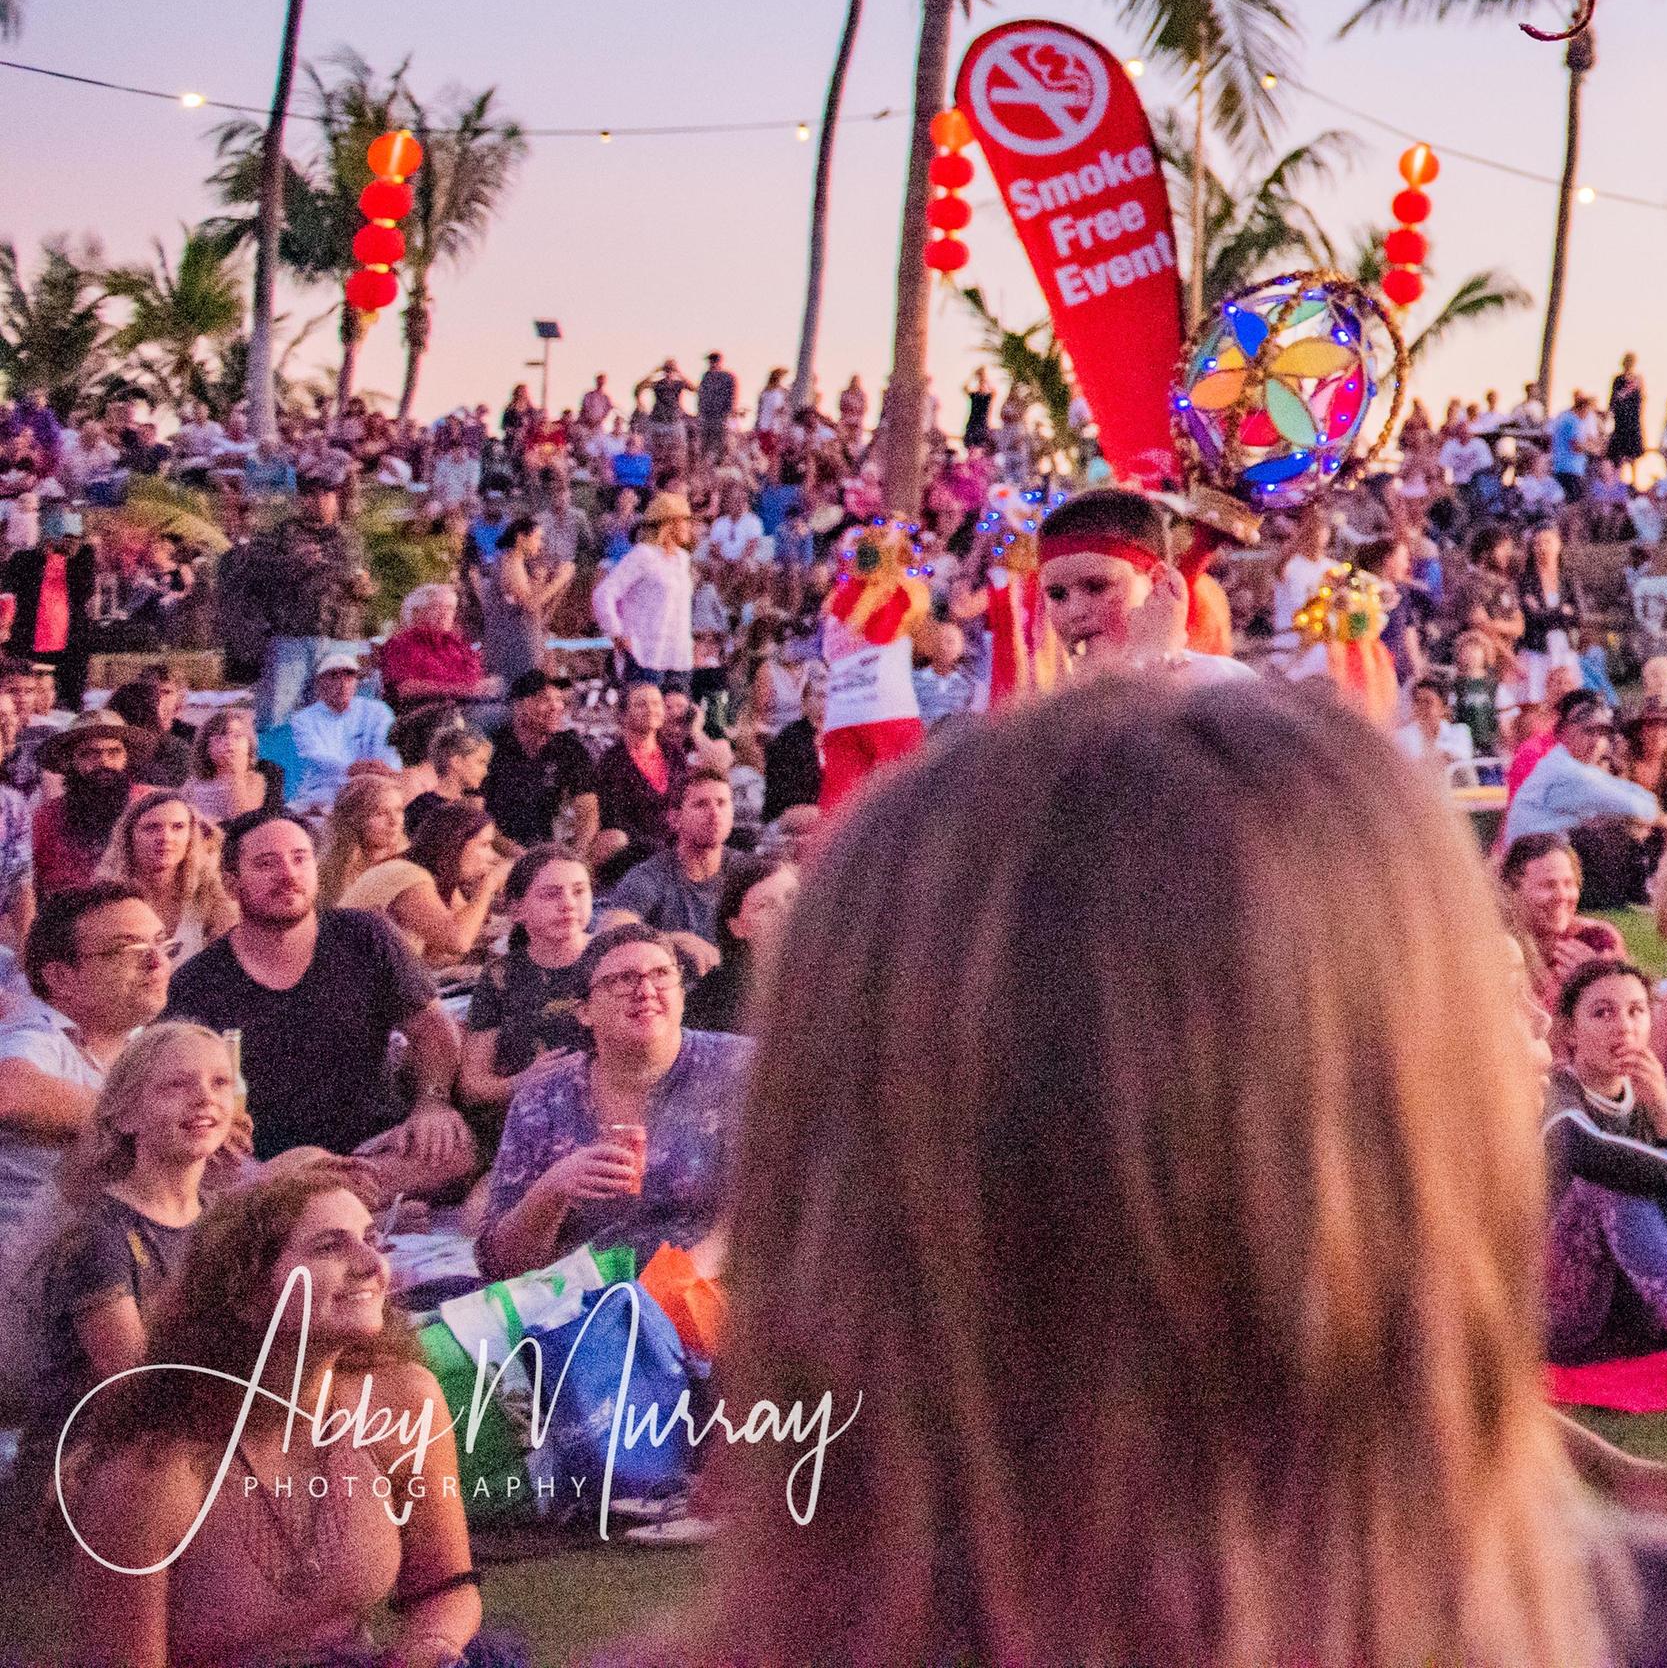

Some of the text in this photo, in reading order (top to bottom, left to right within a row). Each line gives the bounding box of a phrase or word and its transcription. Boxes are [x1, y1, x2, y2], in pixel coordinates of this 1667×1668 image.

[1010, 145, 1154, 219] Smoke
[1051, 200, 1145, 258] Free
[1056, 231, 1175, 306] Event
